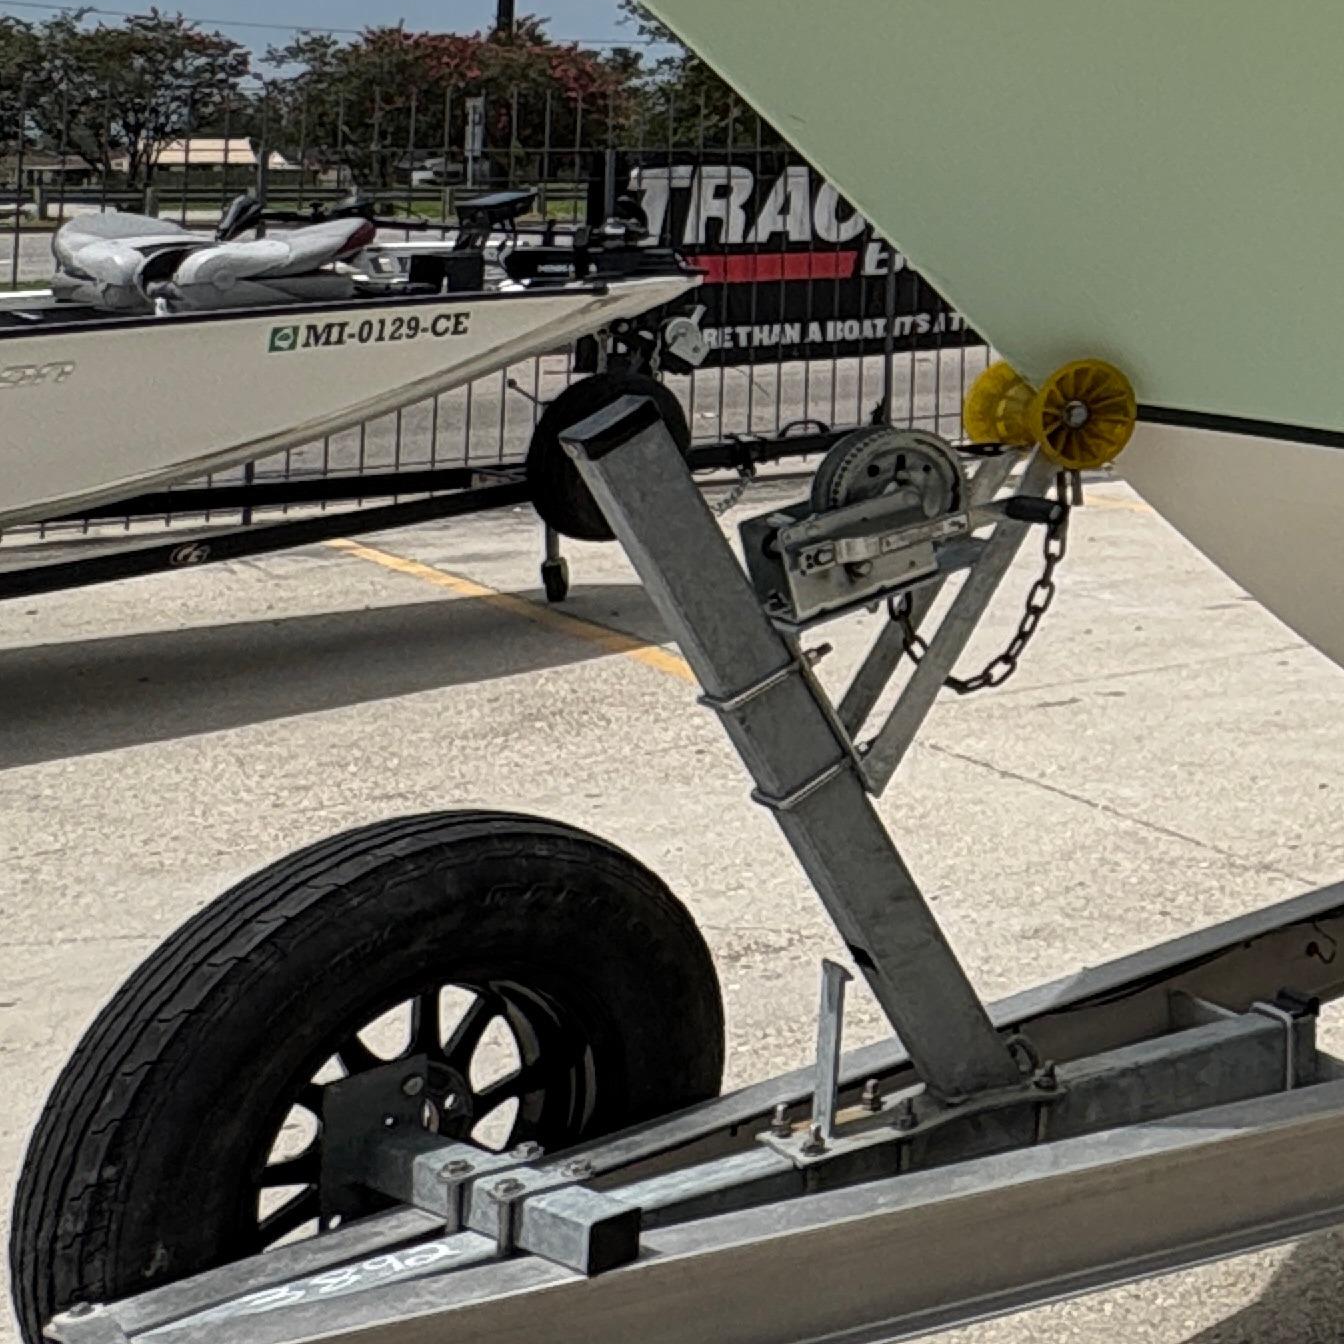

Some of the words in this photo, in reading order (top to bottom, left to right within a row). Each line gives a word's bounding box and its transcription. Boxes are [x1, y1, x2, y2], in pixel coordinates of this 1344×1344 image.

[627, 164, 882, 246] TRAC
[301, 312, 470, 348] MI-0129-CE
[702, 326, 734, 349] RE
